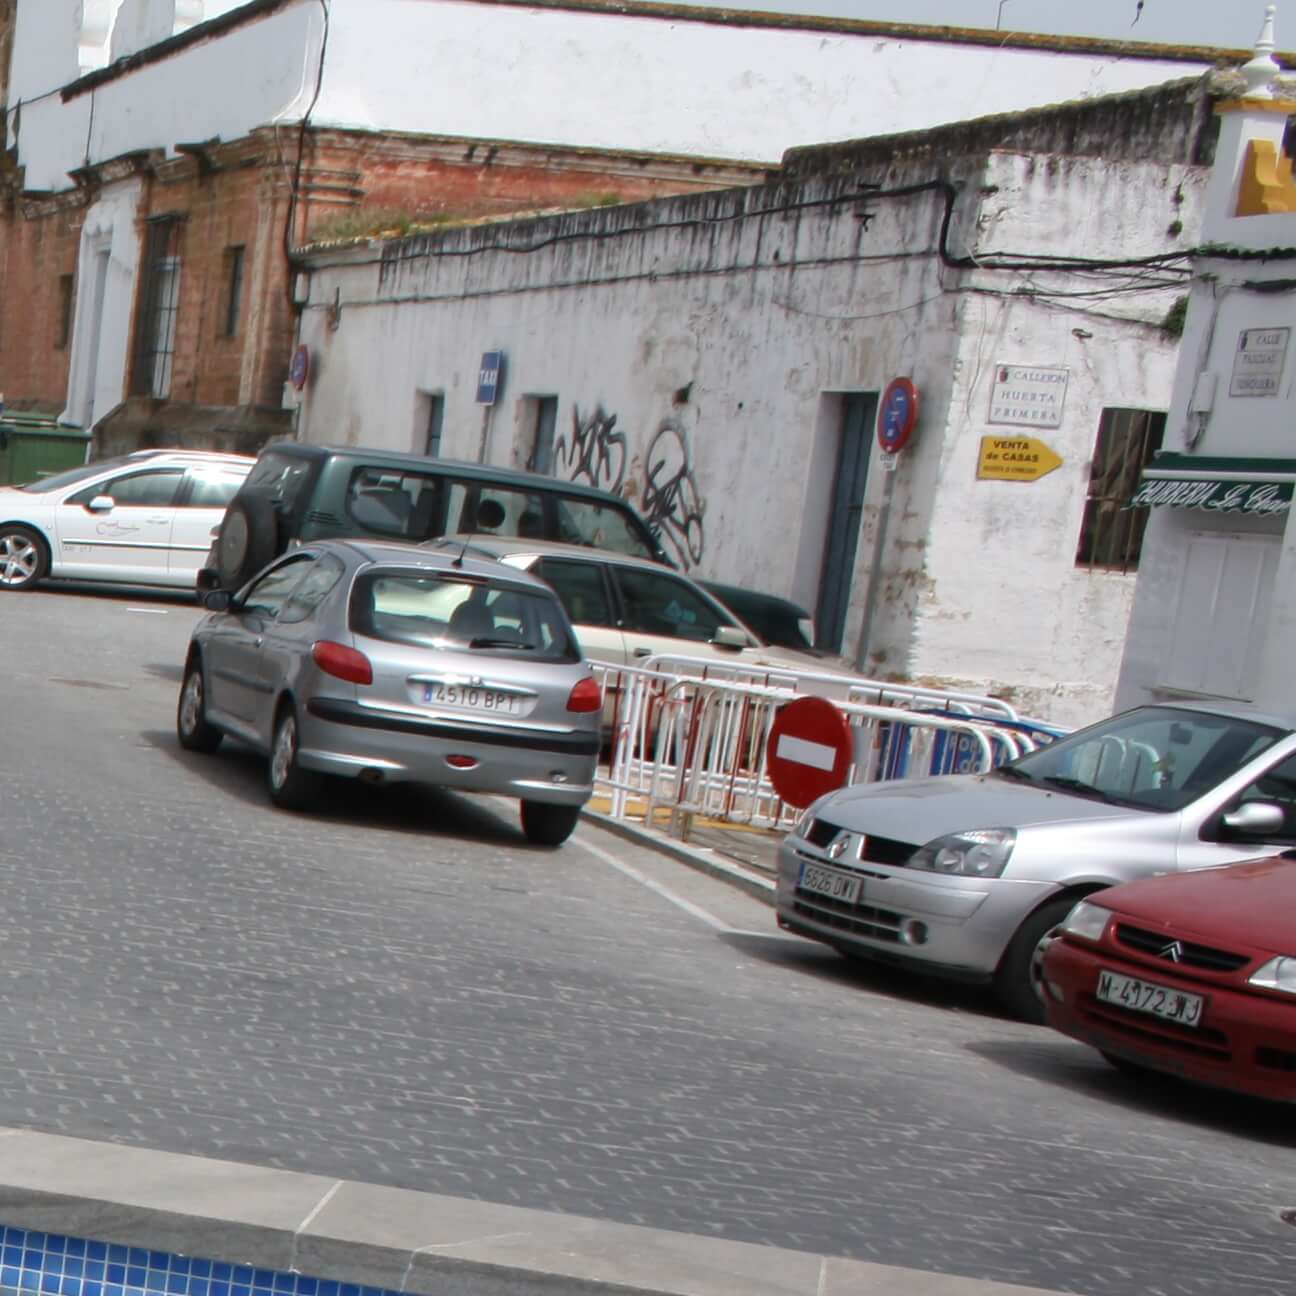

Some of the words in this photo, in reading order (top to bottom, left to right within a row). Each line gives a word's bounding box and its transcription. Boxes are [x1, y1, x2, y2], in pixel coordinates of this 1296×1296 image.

[480, 369, 497, 385] TAXI
[1001, 391, 1056, 402] HUERTA
[993, 440, 1030, 450] VENTA
[985, 452, 999, 461] de
[1002, 452, 1039, 463] CASAS
[436, 686, 479, 706] 4510
[484, 689, 514, 712] BPT
